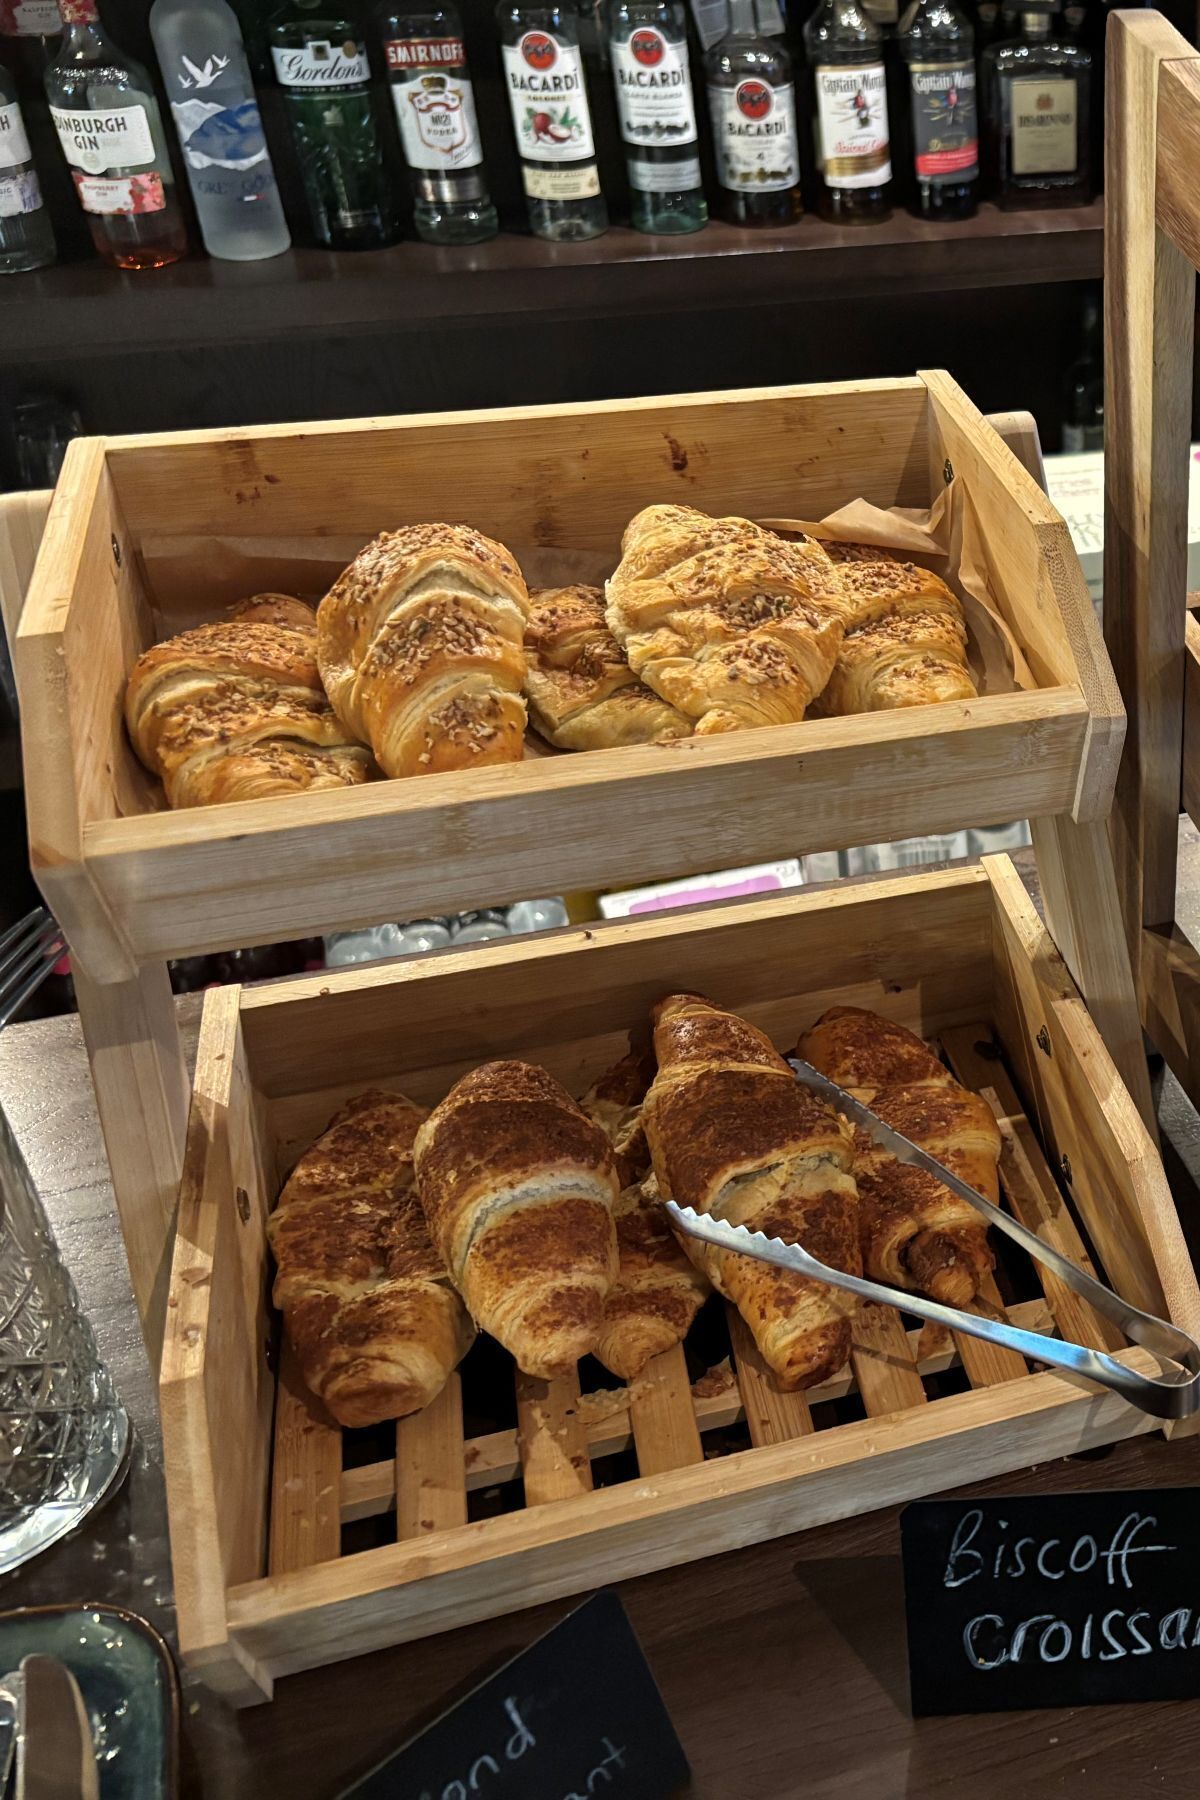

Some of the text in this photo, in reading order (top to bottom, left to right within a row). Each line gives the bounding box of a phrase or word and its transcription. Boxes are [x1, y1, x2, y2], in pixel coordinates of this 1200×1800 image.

[510, 67, 579, 91] BACARDÍ
[618, 63, 686, 88] BACARDÍ
[74, 135, 100, 150] GIN
[943, 1509, 1178, 1588] Biscoff
